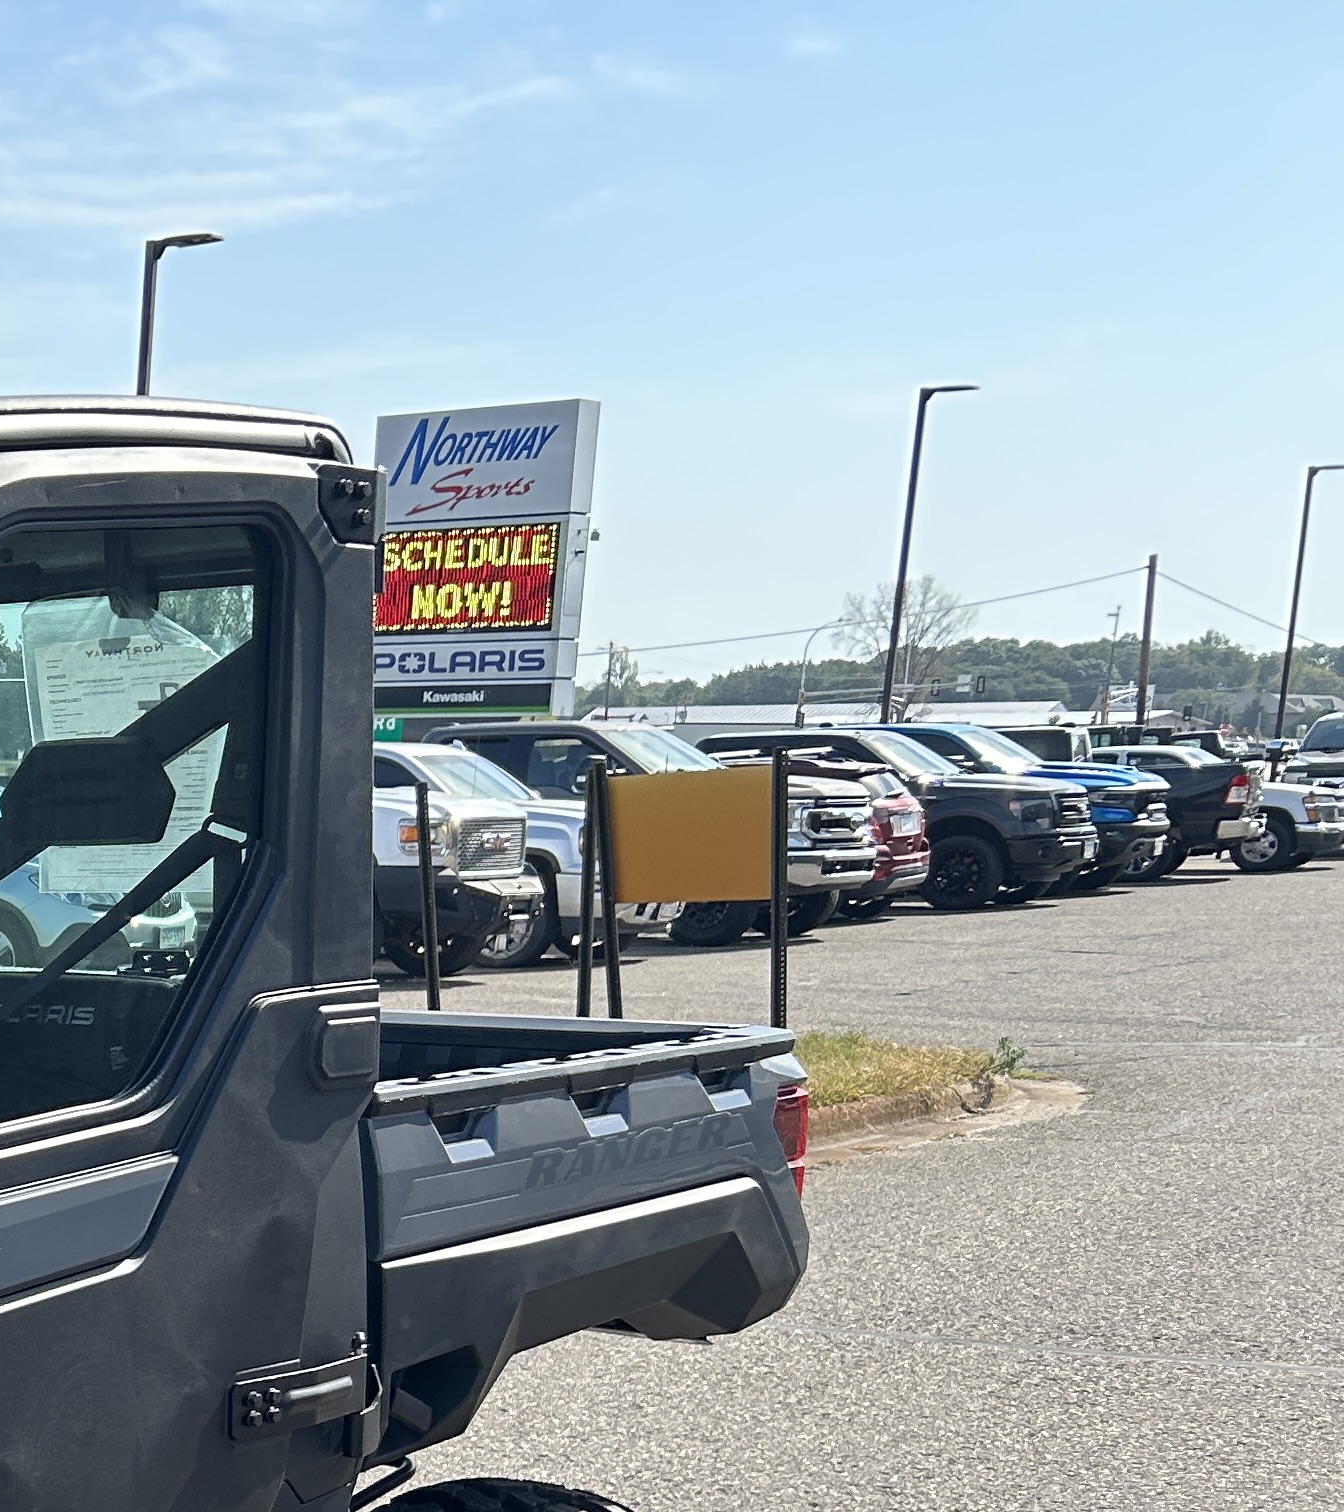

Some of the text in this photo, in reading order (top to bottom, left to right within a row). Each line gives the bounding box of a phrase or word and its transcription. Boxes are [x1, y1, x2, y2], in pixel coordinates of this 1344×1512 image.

[405, 468, 535, 516] Sports
[384, 534, 550, 572] SCHEDULE
[411, 581, 512, 619] NOW!
[374, 649, 546, 674] POLARIS
[423, 690, 485, 704] Kawasaki
[374, 717, 396, 730] Rd
[523, 1112, 732, 1190] RANGER
